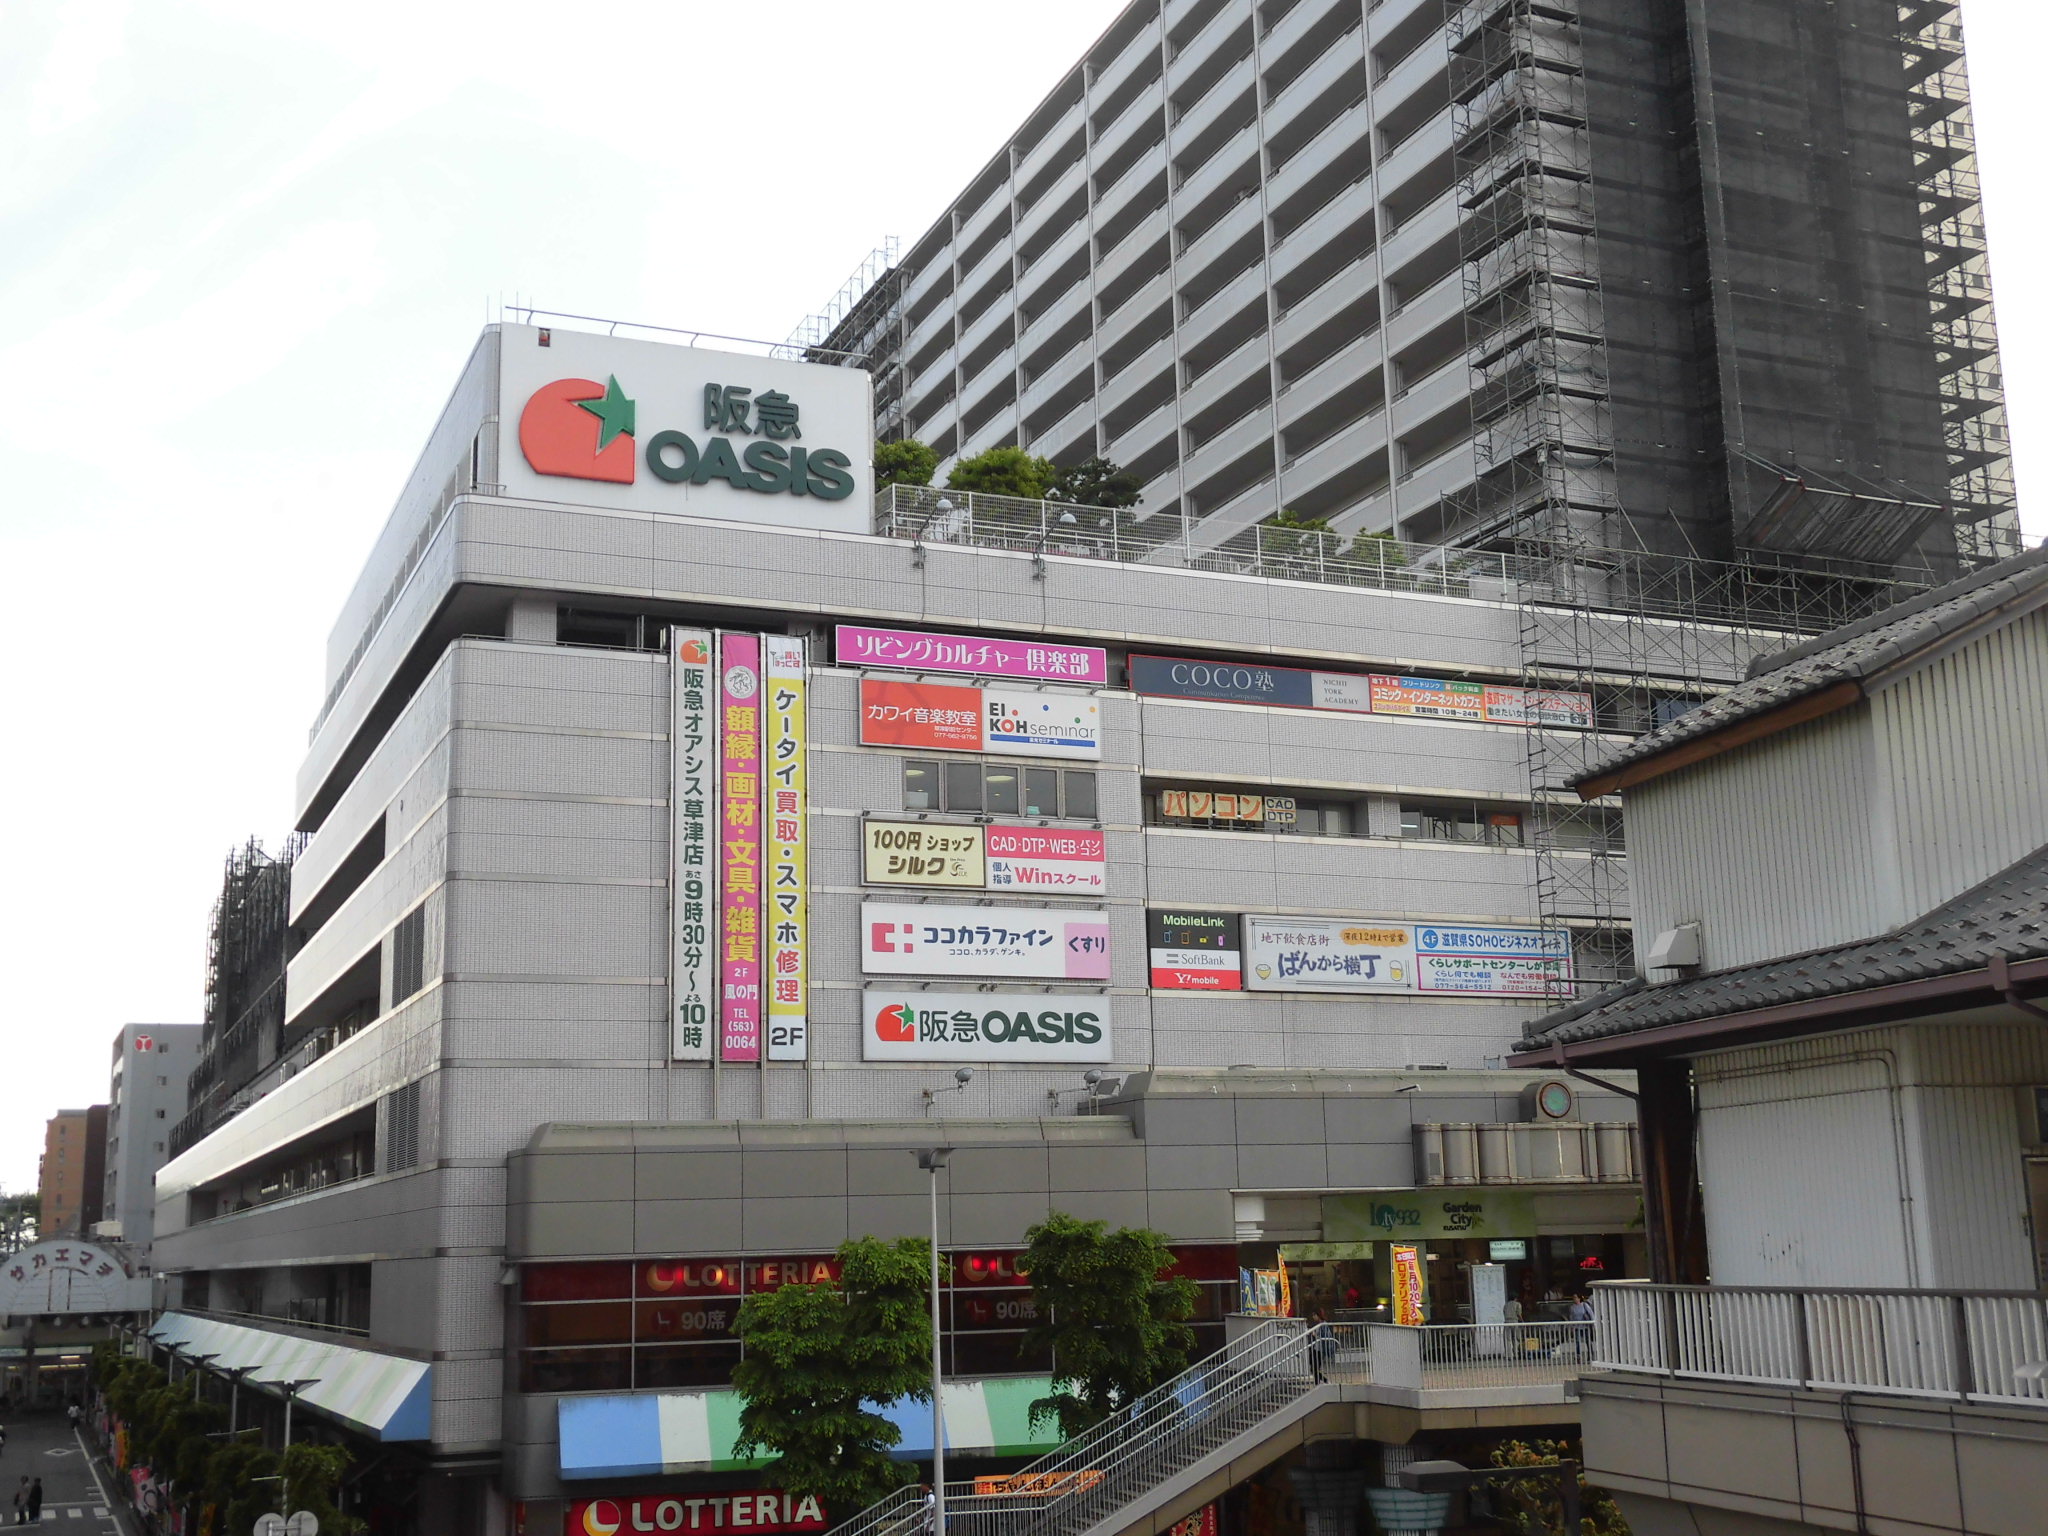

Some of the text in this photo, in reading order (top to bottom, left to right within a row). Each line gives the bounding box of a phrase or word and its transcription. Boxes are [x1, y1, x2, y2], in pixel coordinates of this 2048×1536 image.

[703, 382, 802, 440] 阪急
[646, 429, 855, 501] OASIS
[855, 634, 1090, 676] リビングカルチャー倶楽部
[1171, 664, 1274, 693] COCO塾
[1324, 688, 1343, 696] YORK
[1374, 687, 1482, 708] コミック・インターネットカフェ
[868, 704, 977, 727] カワイ音楽教室
[989, 702, 1005, 717] EI
[1030, 722, 1095, 739] seminar
[683, 668, 704, 865] 阪急オアシス草津店
[1164, 791, 1261, 819] パソコン
[1266, 798, 1294, 810] CAD
[1267, 811, 1294, 822] DTP
[726, 705, 756, 963] 額縁・画材・文具・雑貨
[873, 829, 975, 851] 100円 ショップ
[775, 689, 799, 1003] ケータイ買取・スマホ修理
[685, 870, 701, 878] あさ
[887, 855, 945, 876] シルク
[992, 862, 1011, 873] 個人
[992, 873, 1012, 885] 指導
[1015, 867, 1101, 887] Winスクール
[1163, 914, 1225, 927] MobileLink
[923, 926, 1053, 947] ココカラファイン
[1068, 935, 1105, 954] くすり
[1260, 932, 1330, 947] 地下飲食店街
[1181, 953, 1225, 966] SoftBank
[1277, 951, 1381, 979] ばんから横丁
[734, 968, 748, 977] 2F
[685, 994, 700, 1002] よる
[725, 984, 758, 999] 風の門
[733, 1008, 749, 1018] TEL
[728, 1022, 754, 1033] (563)
[771, 1027, 803, 1046] 2F
[725, 1036, 757, 1049] 0064
[1443, 1202, 1482, 1213] Garden
[1450, 1214, 1472, 1227] City
[682, 1261, 831, 1288] LOTTERIA
[681, 1310, 726, 1331] 90席
[631, 1494, 822, 1532] LOTTERIA
